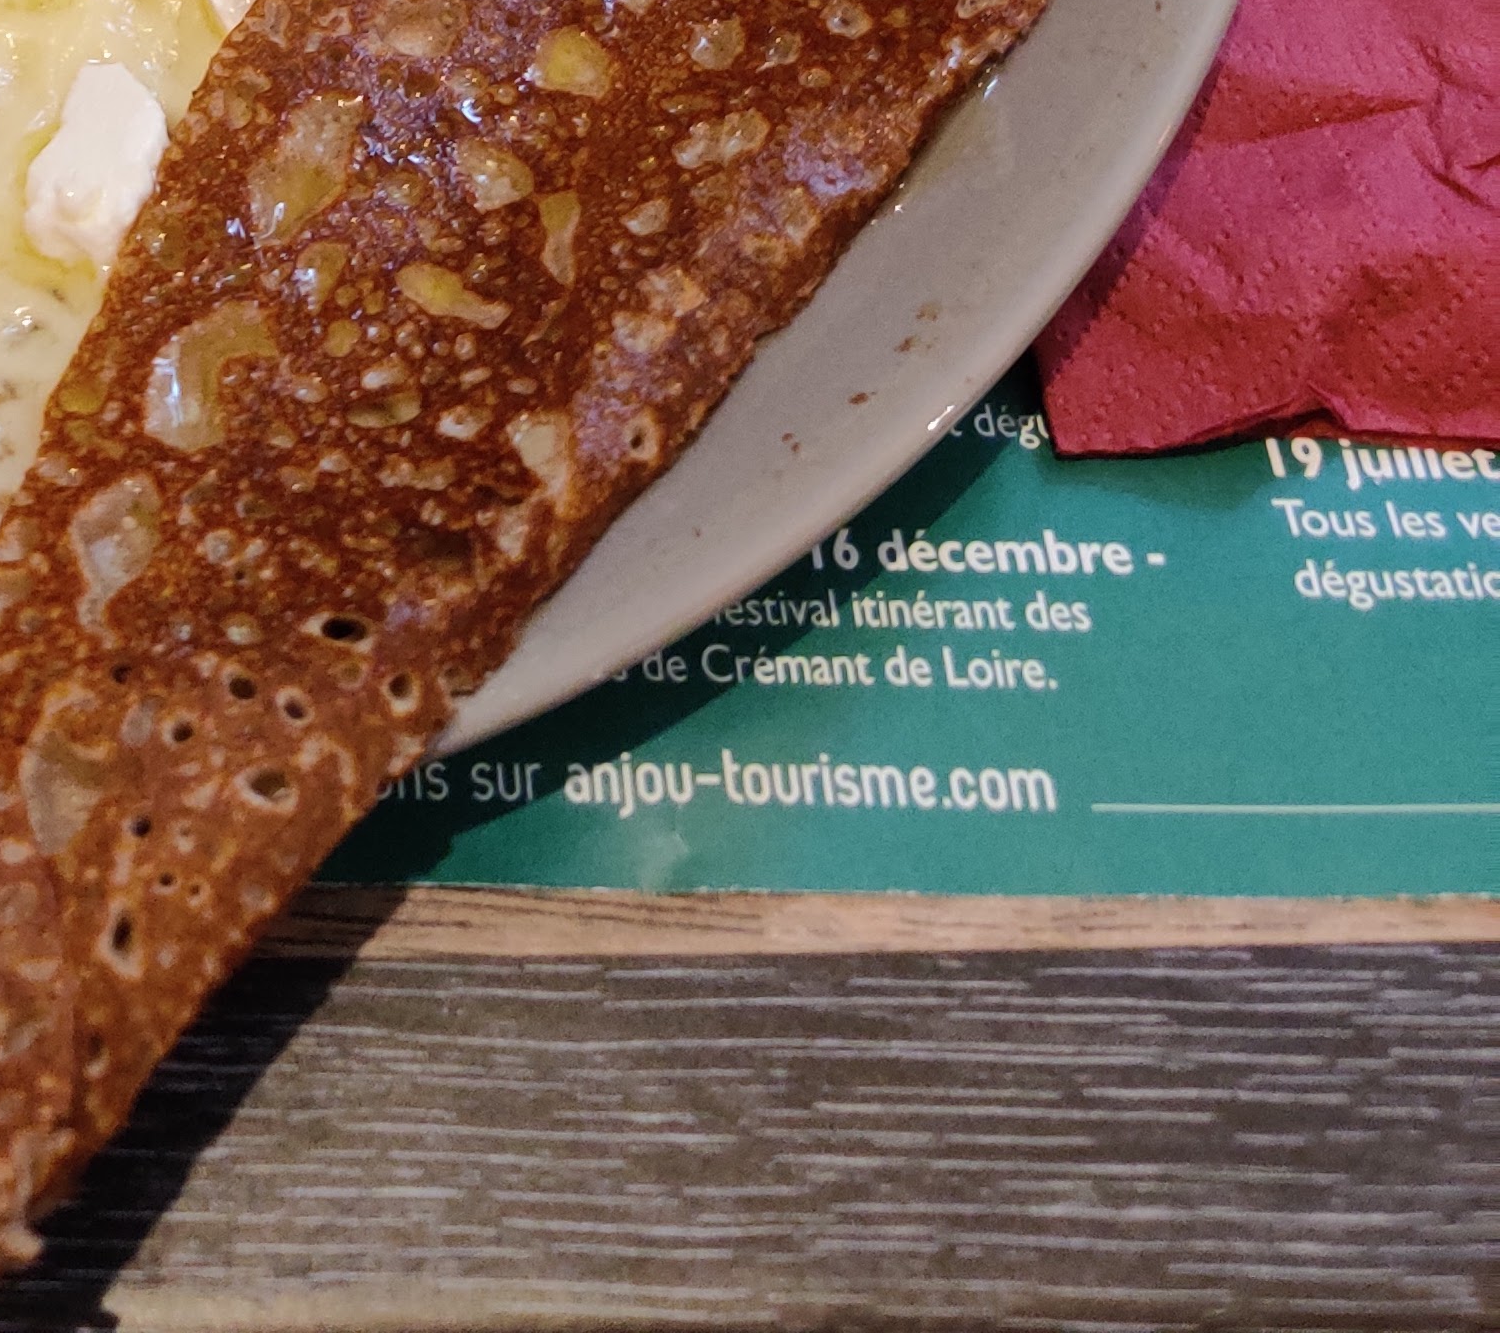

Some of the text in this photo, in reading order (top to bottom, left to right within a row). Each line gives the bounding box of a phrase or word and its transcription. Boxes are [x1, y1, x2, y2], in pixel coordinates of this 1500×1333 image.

[1265, 436, 1500, 490] 19 juillet
[1271, 498, 1377, 538] Tous
[1385, 500, 1447, 538] les
[877, 530, 1133, 575] décembre
[851, 590, 1014, 631] itinérant
[1025, 590, 1092, 632] des
[642, 643, 1060, 690] de Crémant de Loire.
[470, 761, 543, 802] sur
[563, 748, 1058, 820] anjou-tourisme.com
